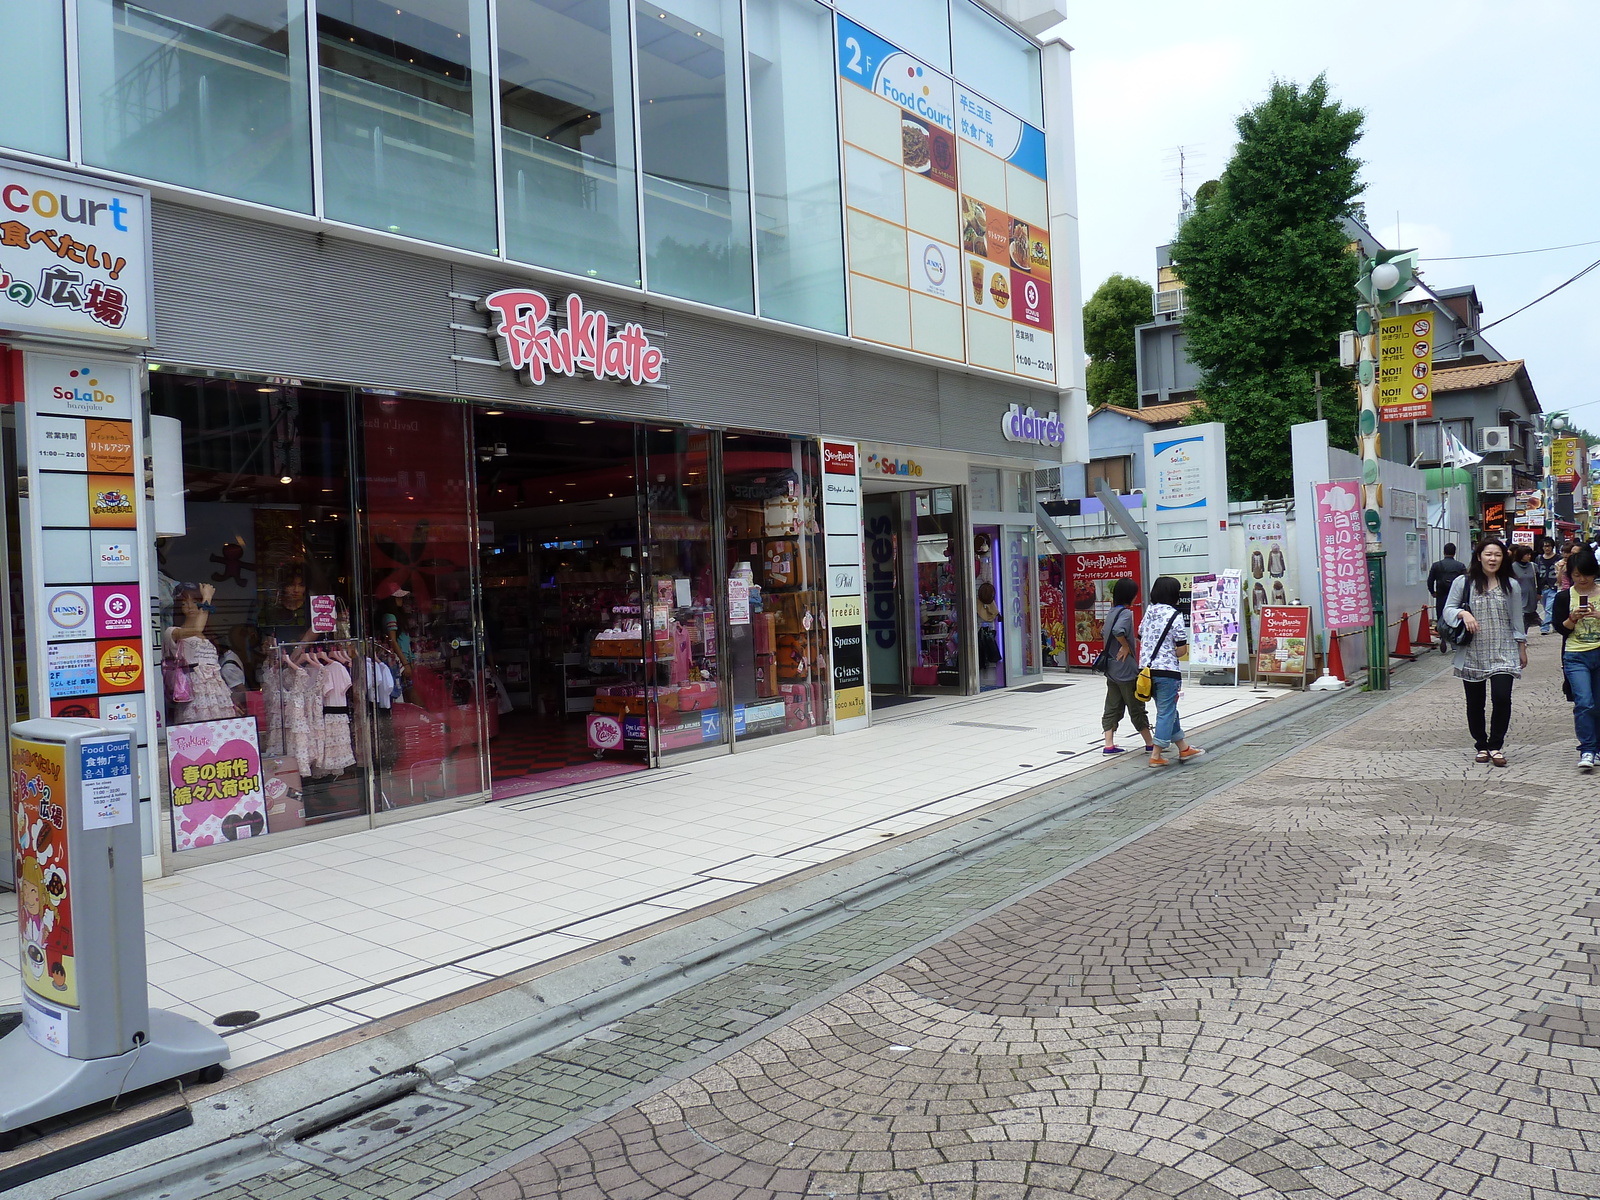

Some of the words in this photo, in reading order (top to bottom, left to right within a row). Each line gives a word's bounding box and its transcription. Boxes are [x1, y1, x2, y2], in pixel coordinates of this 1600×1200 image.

[883, 77, 915, 110] Food
[917, 97, 952, 130] Court
[960, 94, 993, 125] 푸드코트
[960, 117, 994, 148] 饮食广场
[2, 184, 128, 232] court
[0, 264, 129, 329] の広場
[53, 386, 115, 403] SoLaDo
[1010, 406, 1065, 442] claire's
[45, 431, 77, 440] 営業時間
[91, 442, 131, 453] リトルアジア
[881, 457, 923, 477] SoLaDo
[1174, 543, 1192, 553] Phil
[101, 554, 131, 562] SoLaDo
[1334, 512, 1357, 611] 白いたい焼き
[835, 573, 854, 588] Phil
[834, 636, 860, 649] Spasso
[50, 672, 60, 680] 2F
[834, 666, 860, 678] Glass
[108, 712, 137, 721] SoLaDo
[82, 745, 105, 754] Food
[106, 743, 130, 752] Court
[84, 768, 104, 779] 음식
[110, 764, 129, 776] 광장
[183, 759, 249, 784] 春の新作
[174, 776, 260, 806] 続々入荷中!
